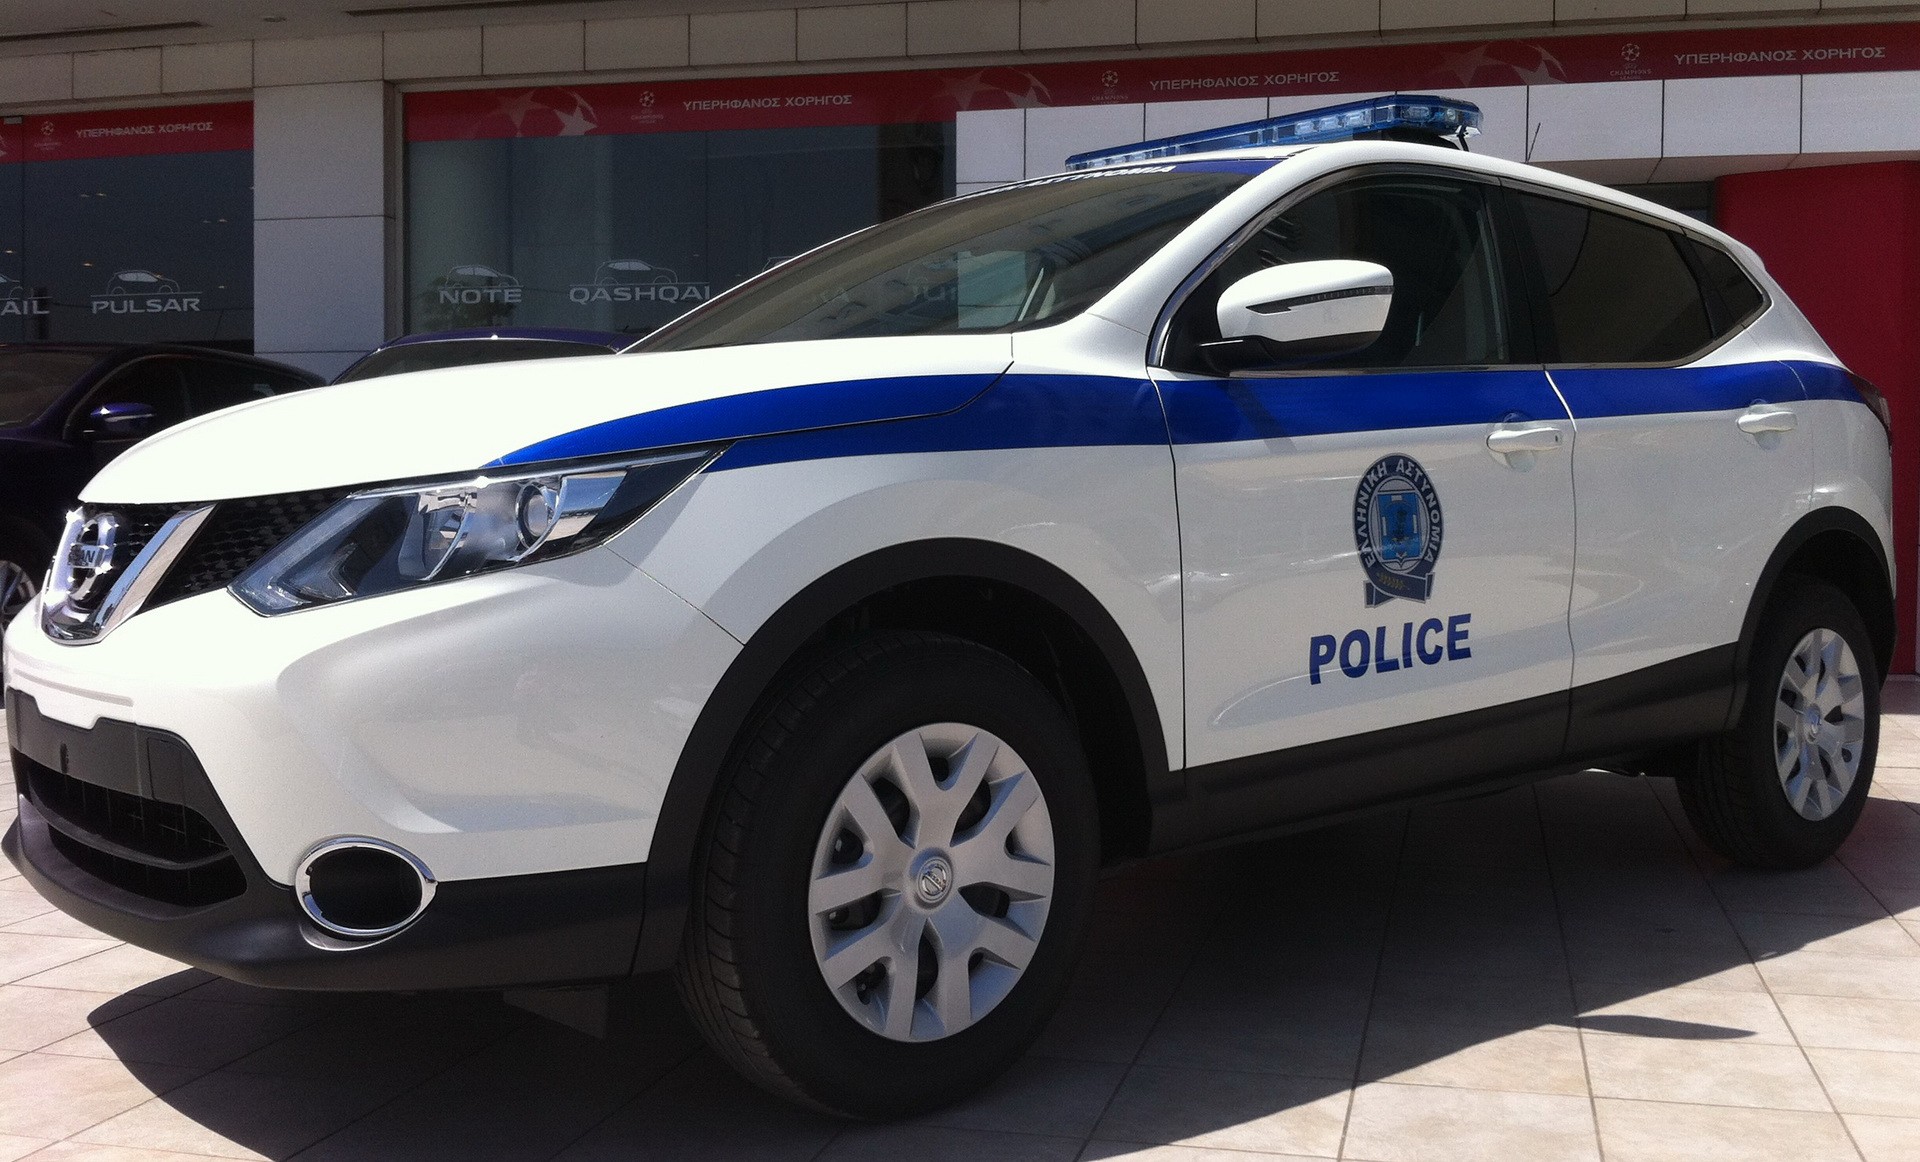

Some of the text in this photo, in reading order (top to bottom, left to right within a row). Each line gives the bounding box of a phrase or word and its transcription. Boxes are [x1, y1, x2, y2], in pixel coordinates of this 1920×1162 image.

[1674, 46, 1886, 66] ΥΠΕΡΗΦΑΝΟΣ ΧΟΡΗΓΟΣ
[1150, 70, 1340, 92] ΥΠΕΡΗΦΑΝΟΣ ΧΟΡΗΓΟΣ
[682, 94, 852, 111] ΥΠΕΡΗΦΑΝΟΣ ΧΟΡΗΓΟΣ
[76, 121, 214, 138] ΥΠΕΡΗΦΑΝΟΣ ΧΟΡΗΓΟΣ
[438, 288, 523, 304] NOTE
[569, 284, 711, 305] QASHQAI
[91, 297, 202, 315] PULSAR
[1354, 458, 1442, 568] ΕΛΛΗΝΙΚΗ ΑΣΤΥΝΟΜΙΑ
[1308, 613, 1472, 685] POLICE
